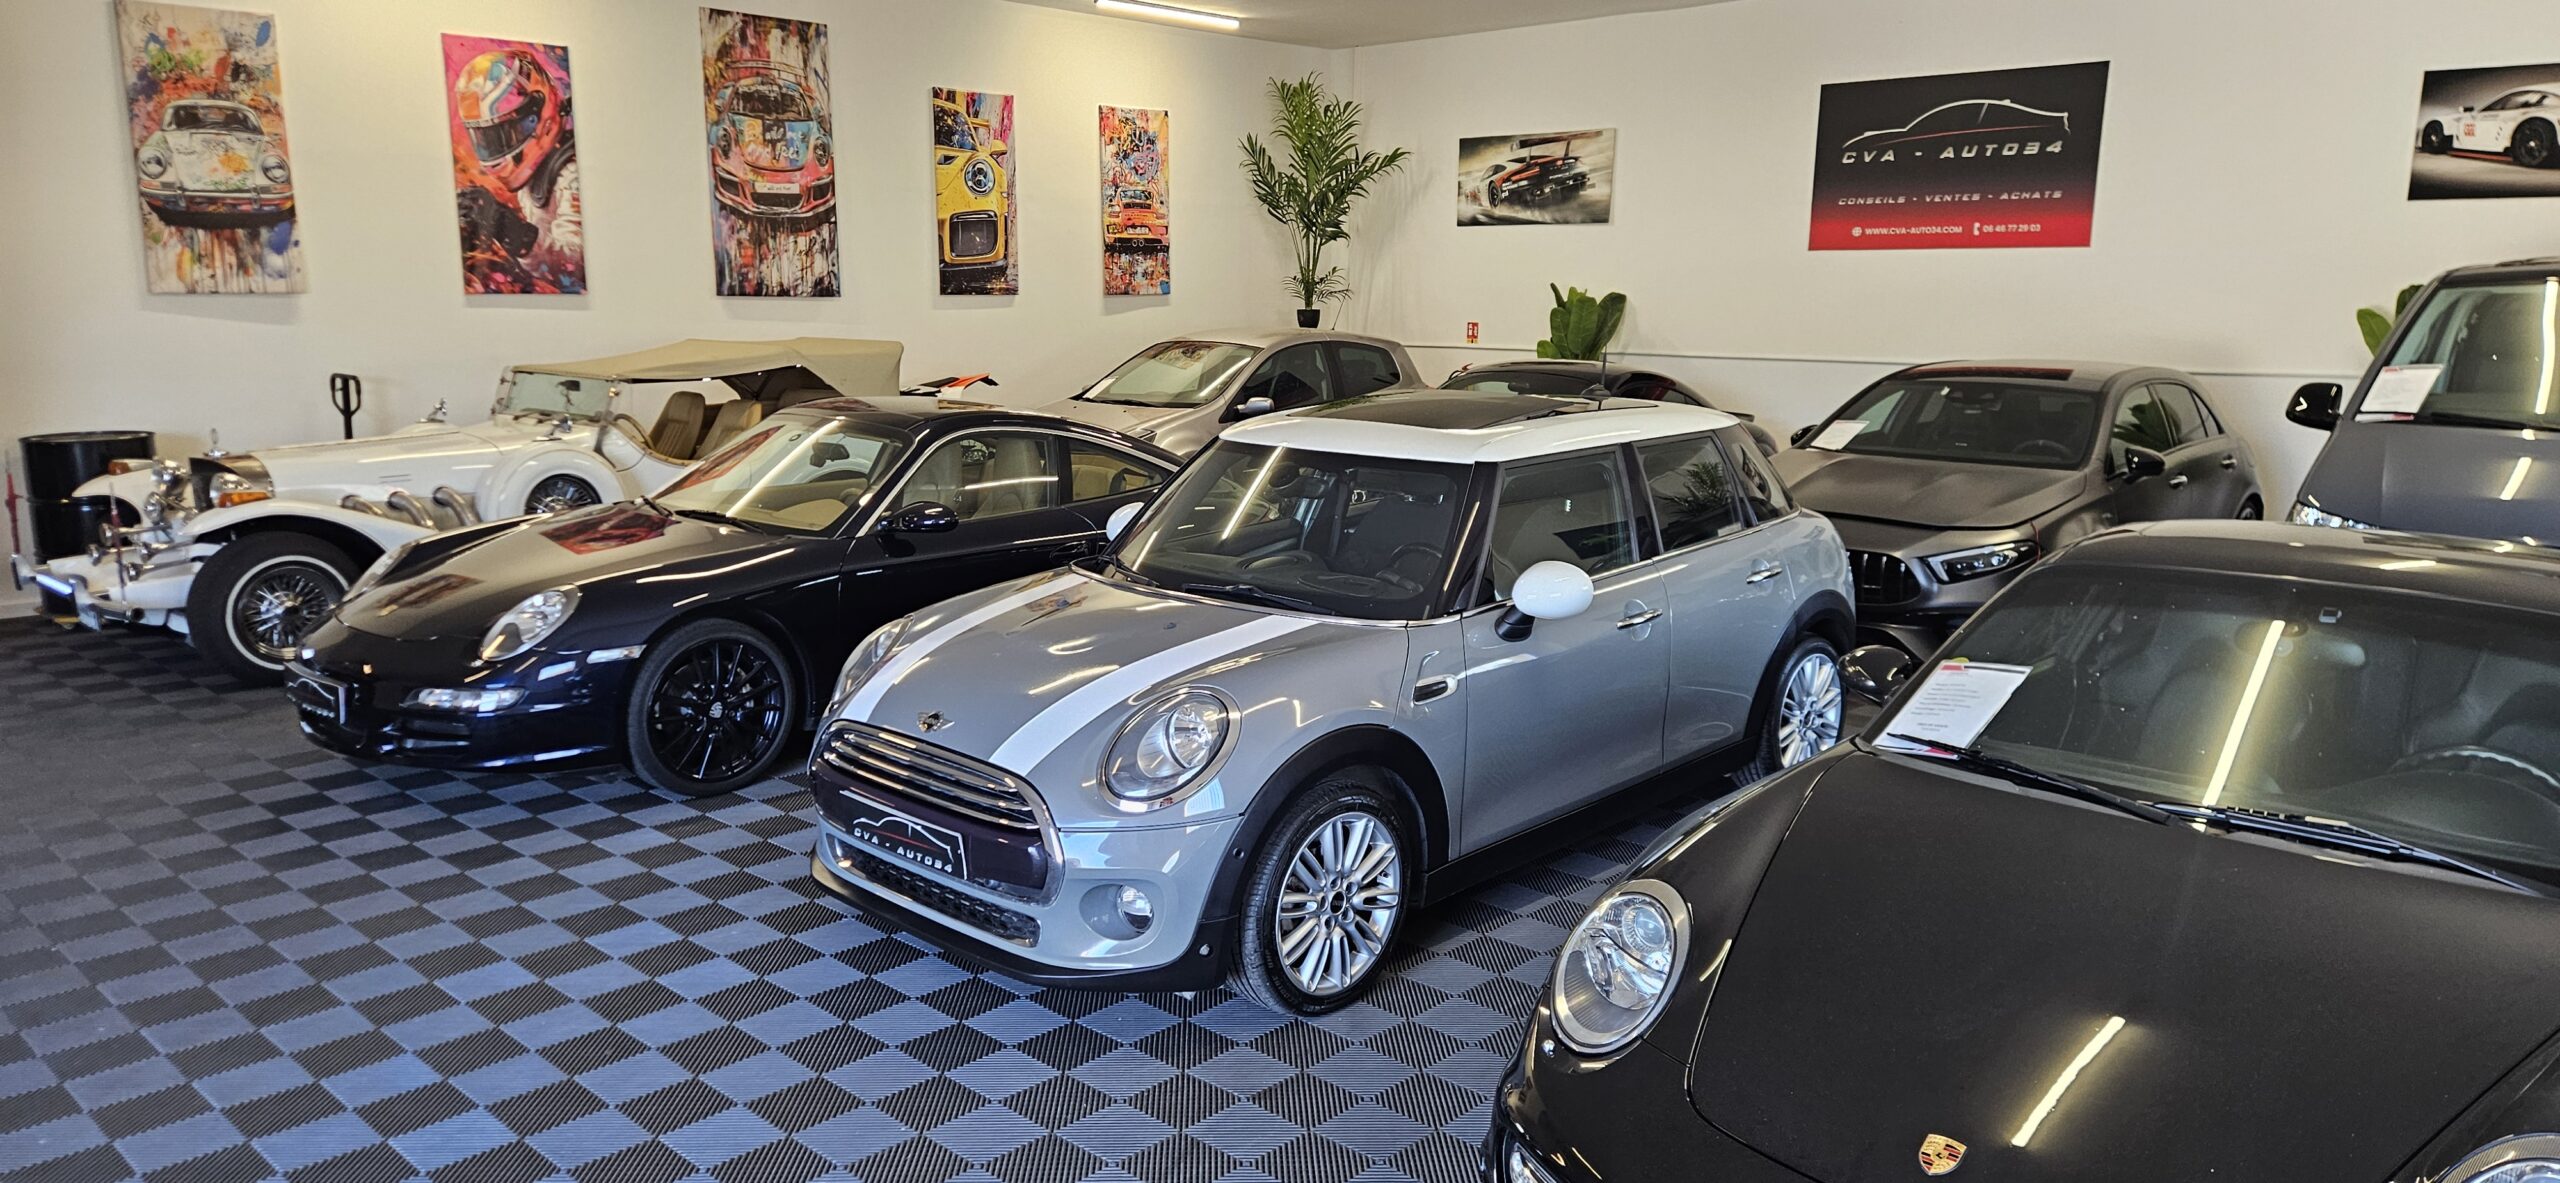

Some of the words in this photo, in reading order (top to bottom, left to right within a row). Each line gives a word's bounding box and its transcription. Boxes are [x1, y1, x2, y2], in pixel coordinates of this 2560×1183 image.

[1842, 150, 1895, 164] CVA
[1939, 141, 2063, 159] AUTO34
[1838, 196, 1906, 205] CONSEILS
[1924, 193, 1981, 203] VENTES
[1999, 190, 2062, 200] ACHATS
[1865, 226, 1963, 235] WWW.CVA-AUTO34.COM
[854, 828, 879, 845] CVA
